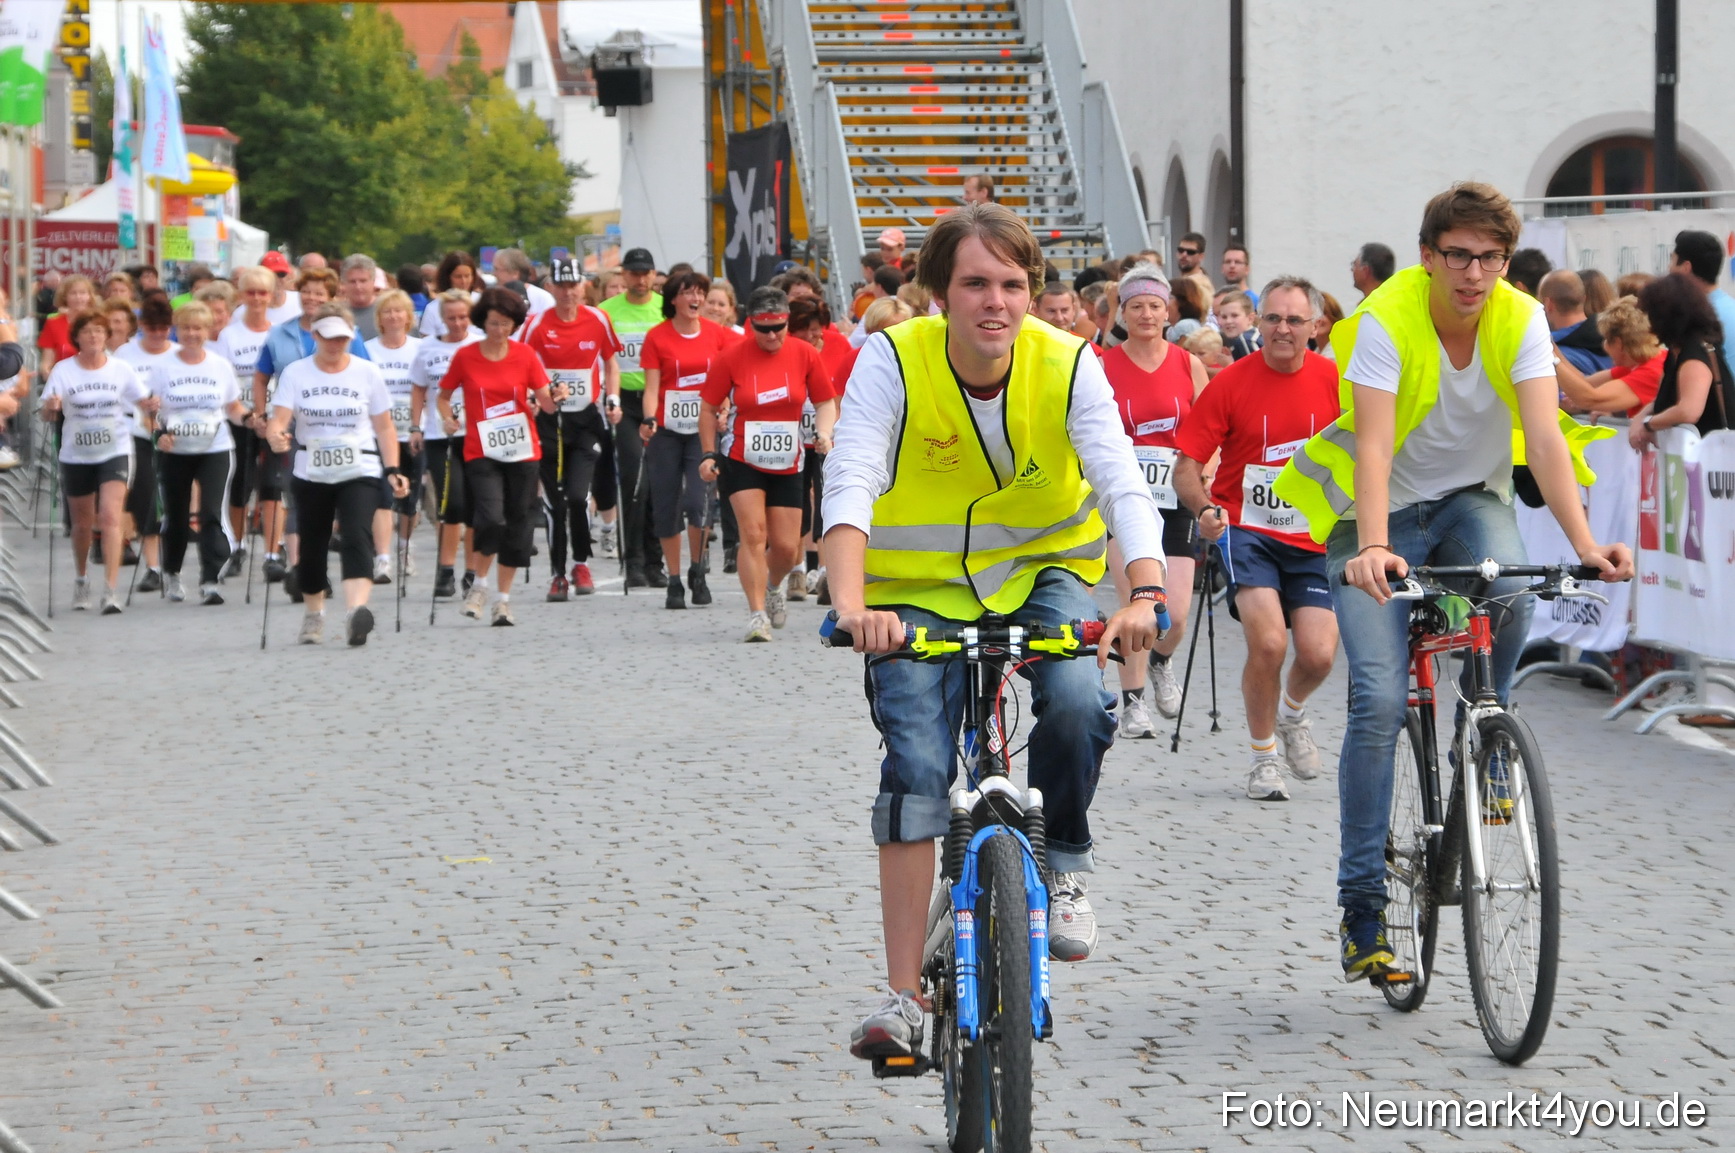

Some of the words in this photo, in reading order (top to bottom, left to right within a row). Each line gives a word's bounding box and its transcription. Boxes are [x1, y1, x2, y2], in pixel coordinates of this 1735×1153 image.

[47, 230, 119, 243] ZELTVERLEI
[301, 386, 359, 399] BERGER
[561, 380, 586, 396] 55
[173, 422, 208, 438] 8087
[1147, 422, 1165, 430] DEHN
[75, 429, 111, 447] 8085
[488, 425, 526, 448] 8034
[751, 434, 793, 452] 8039
[313, 447, 354, 467] 8089
[1278, 445, 1298, 455] DEHN
[758, 455, 785, 464] Brigitte
[1266, 515, 1295, 526] Josef
[1029, 911, 1046, 921] ROCK
[1040, 956, 1050, 998] SID
